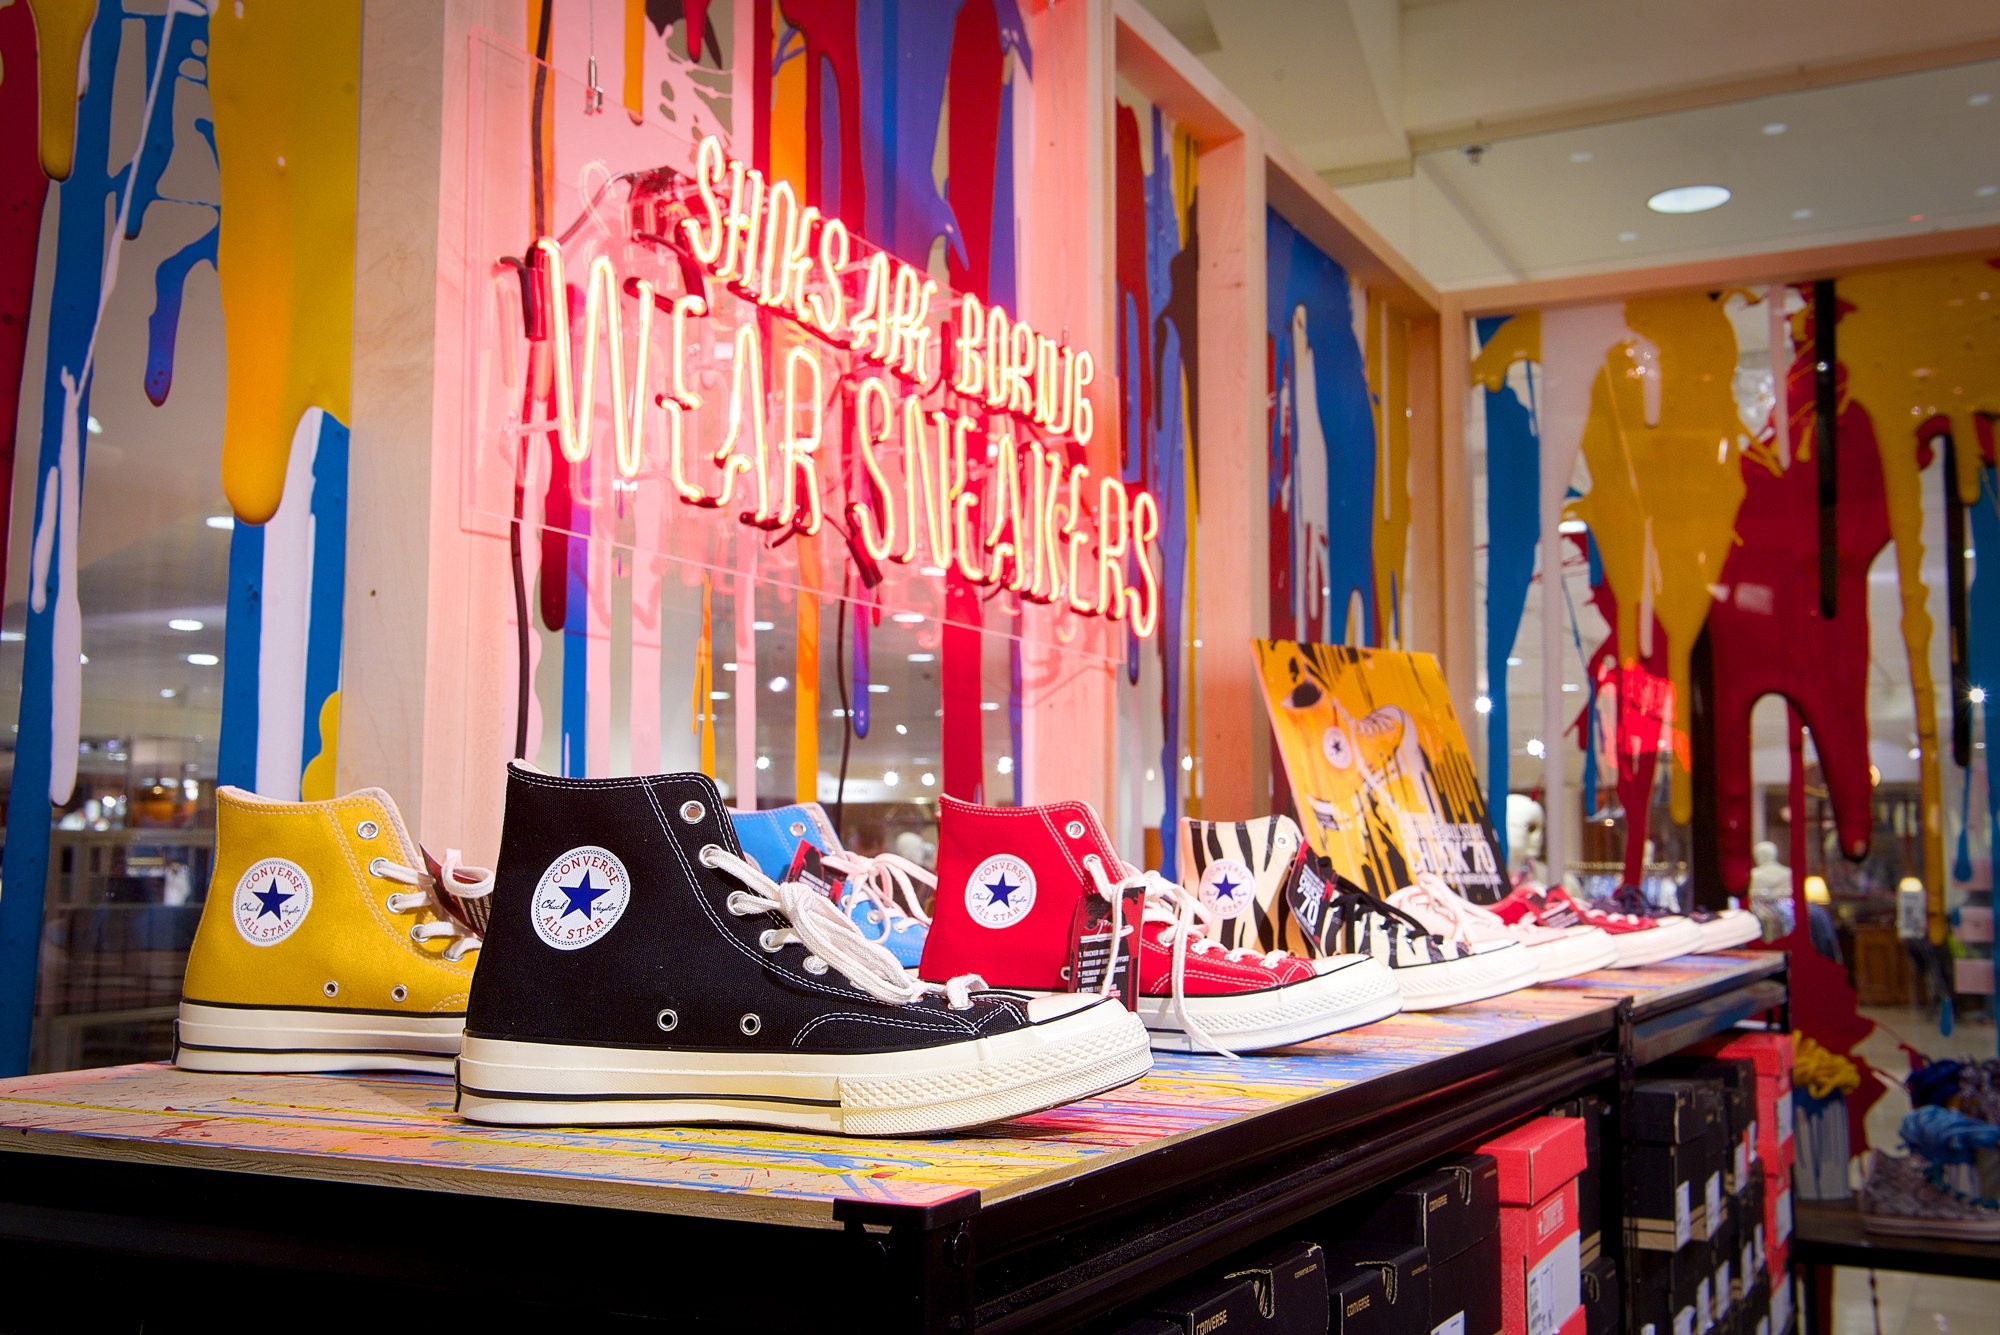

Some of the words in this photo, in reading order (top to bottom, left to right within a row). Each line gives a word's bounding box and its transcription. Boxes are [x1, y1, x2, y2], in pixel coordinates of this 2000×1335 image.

[681, 135, 849, 333] SHOES
[850, 251, 937, 384] ARE
[956, 293, 1094, 445] BORING
[538, 236, 823, 536] WEAR
[849, 376, 1160, 638] SNEAKERS
[246, 866, 303, 892] CONVERSE
[551, 855, 620, 886] CONVERSE
[978, 861, 1027, 884] CONVERSE
[541, 899, 569, 910] Chuck
[975, 904, 989, 920] ALL
[992, 906, 1020, 922] STAR
[243, 917, 259, 936] ALL
[262, 919, 292, 938] STAR
[543, 915, 562, 937] ALL
[566, 917, 605, 940] STAR
[1346, 1295, 1371, 1317] CONVERSE
[1196, 1309, 1228, 1335] CONVERSE
